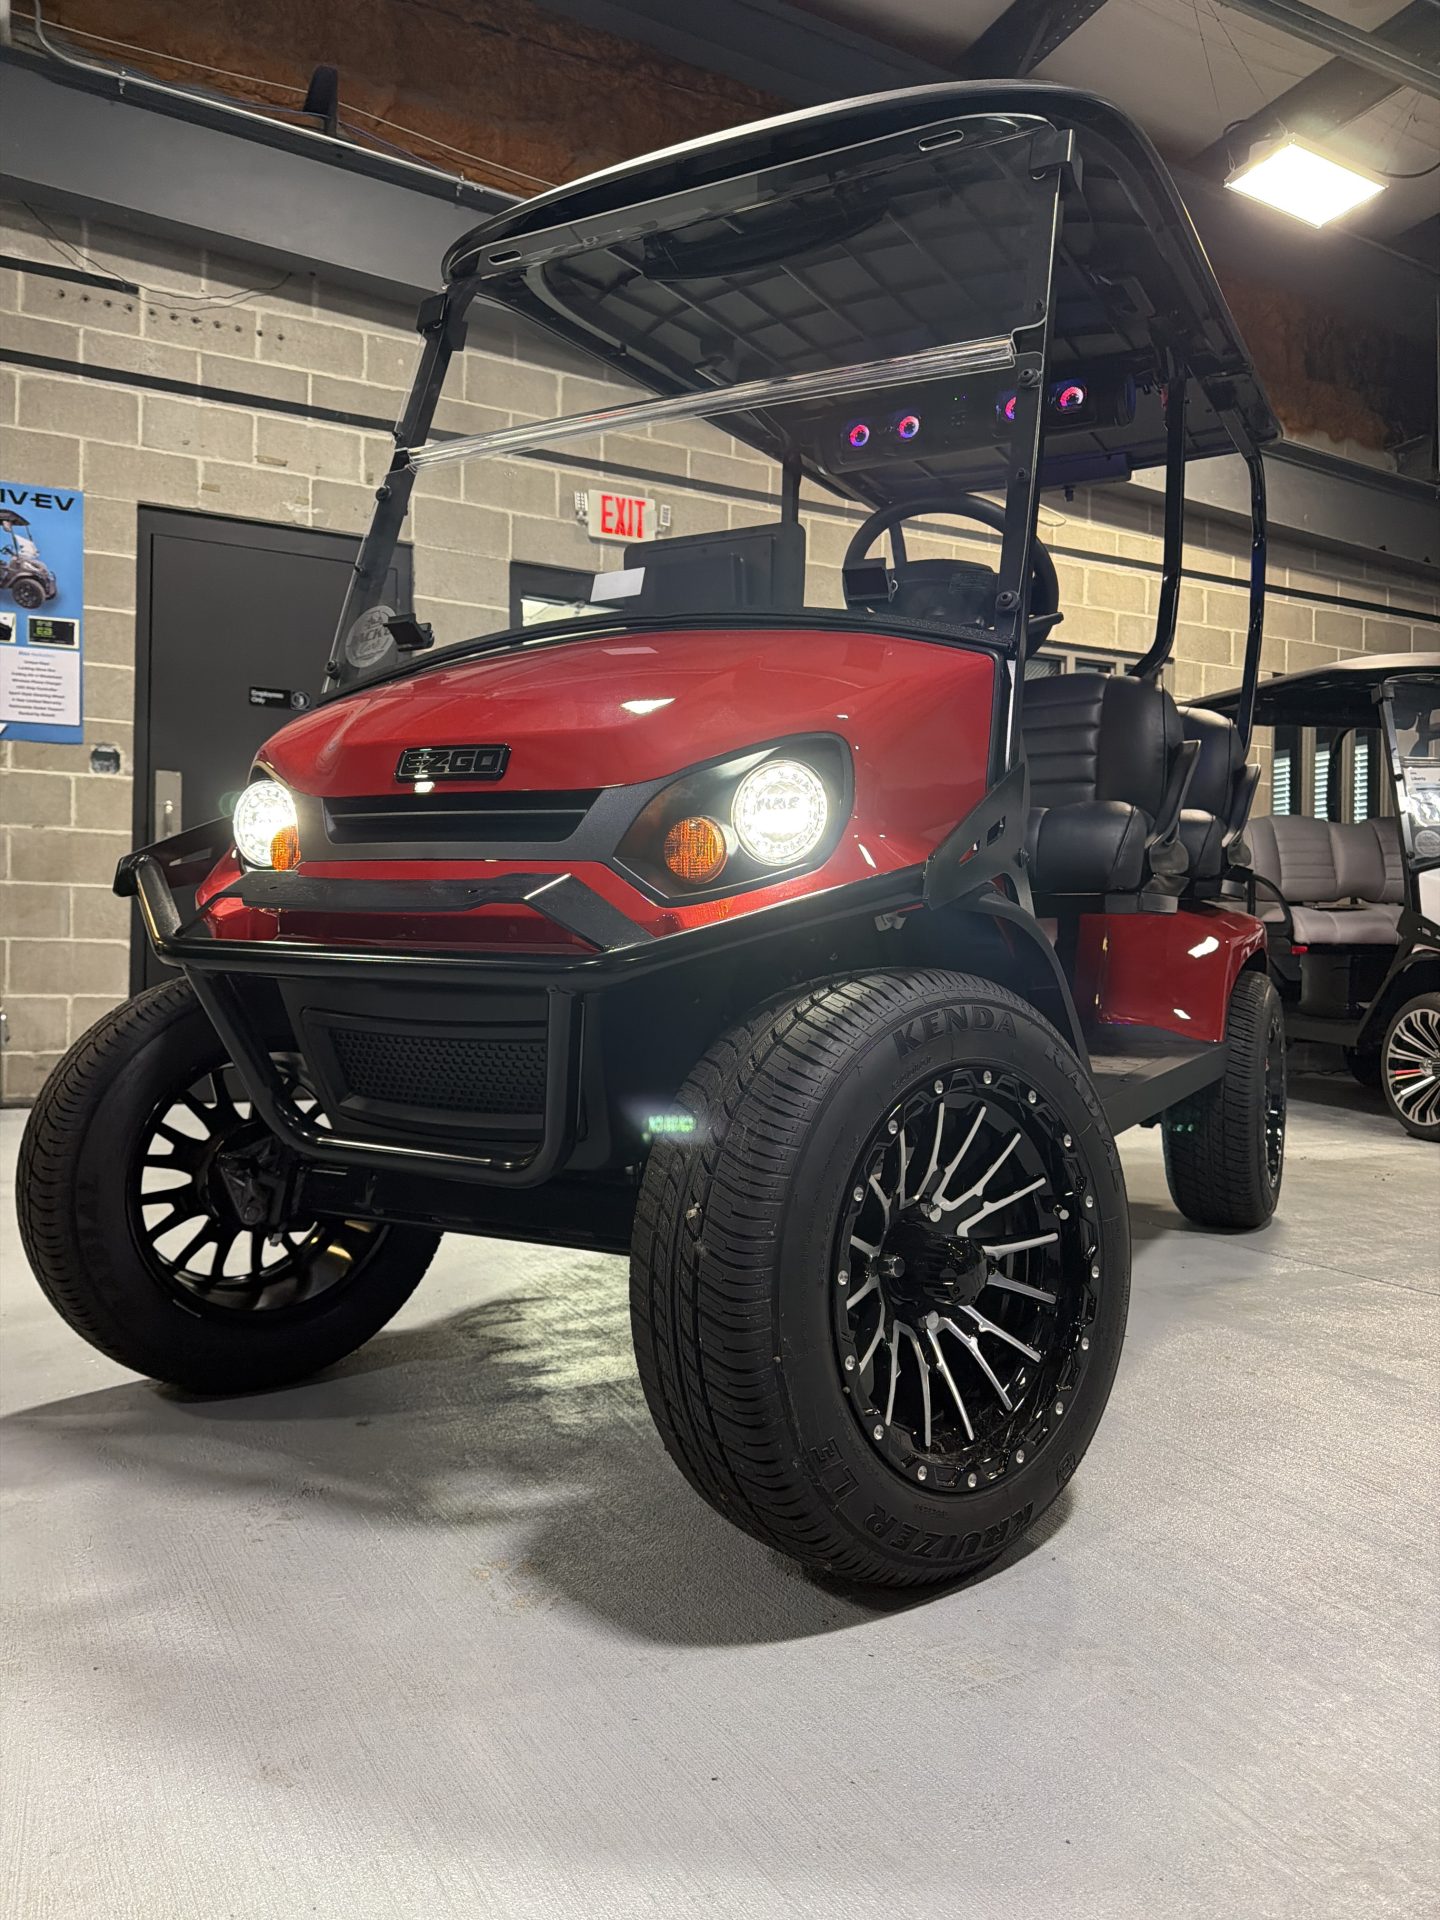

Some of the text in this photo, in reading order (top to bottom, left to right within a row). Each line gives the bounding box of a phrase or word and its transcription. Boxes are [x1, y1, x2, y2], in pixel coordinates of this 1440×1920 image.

[601, 495, 646, 538] EXIT
[892, 1005, 1017, 1055] KENDA
[863, 1501, 1034, 1559] KRUIZER
